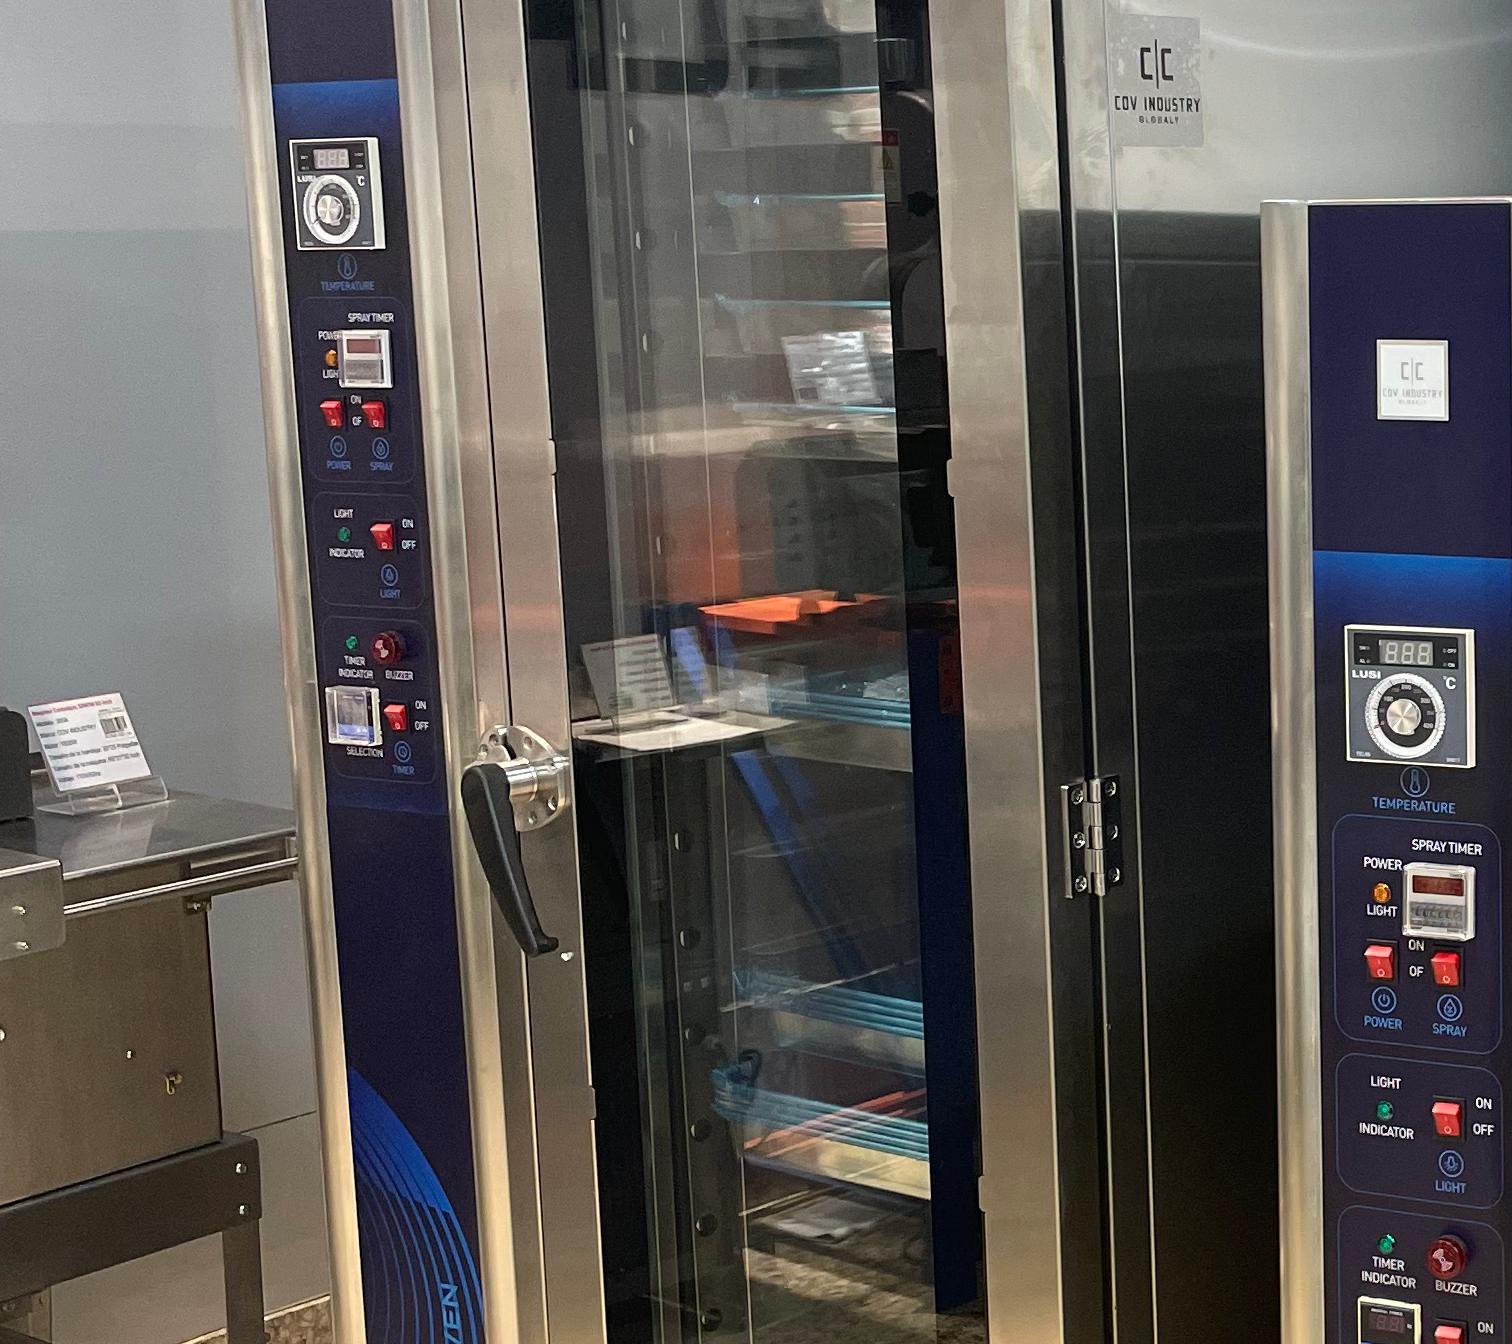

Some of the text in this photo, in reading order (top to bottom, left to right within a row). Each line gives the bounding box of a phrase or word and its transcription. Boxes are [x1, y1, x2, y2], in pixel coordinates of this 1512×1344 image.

[1114, 95, 1201, 113] COV INDUSTRY
[320, 280, 375, 291] TEMPERATURE
[347, 312, 394, 323] SPRAY TIMER
[322, 369, 340, 379] LIGH
[1402, 388, 1443, 398] INDUSTRY
[326, 460, 352, 470] POWER
[369, 461, 394, 471] SPRAY
[333, 508, 354, 519] LIGHT
[402, 518, 414, 529] ON
[401, 539, 417, 550] OFF
[328, 547, 365, 559] INDICATOR
[379, 588, 401, 599] LIGHT
[344, 655, 366, 666] TIMER
[338, 668, 374, 680] INDICATOR
[384, 669, 414, 681] BUZZER
[1351, 669, 1381, 680] LUSI
[414, 700, 427, 711] ON
[414, 720, 429, 731] OFF
[346, 745, 384, 758] SELECTION
[391, 764, 415, 775] TIMER
[1372, 796, 1456, 814] TEMPERATURE
[1411, 838, 1483, 856] SPRAY TIMER
[1363, 856, 1403, 871] POWER
[1366, 903, 1398, 918] LIGHT
[1408, 939, 1425, 951] ON
[1409, 965, 1425, 978] OF
[1363, 1015, 1403, 1030] POWER
[1432, 1022, 1468, 1037] SPRAY
[1370, 1075, 1402, 1090] LIGHT
[1475, 1096, 1492, 1110] ON
[1359, 1122, 1415, 1140] INDICATOR
[1472, 1123, 1495, 1136] OFF
[1435, 1179, 1466, 1194] LIGHT
[1372, 1255, 1405, 1272] TIMER
[1361, 1270, 1417, 1290] INDICATOR
[1435, 1279, 1478, 1297] BUZZER
[1477, 1321, 1494, 1335] ON
